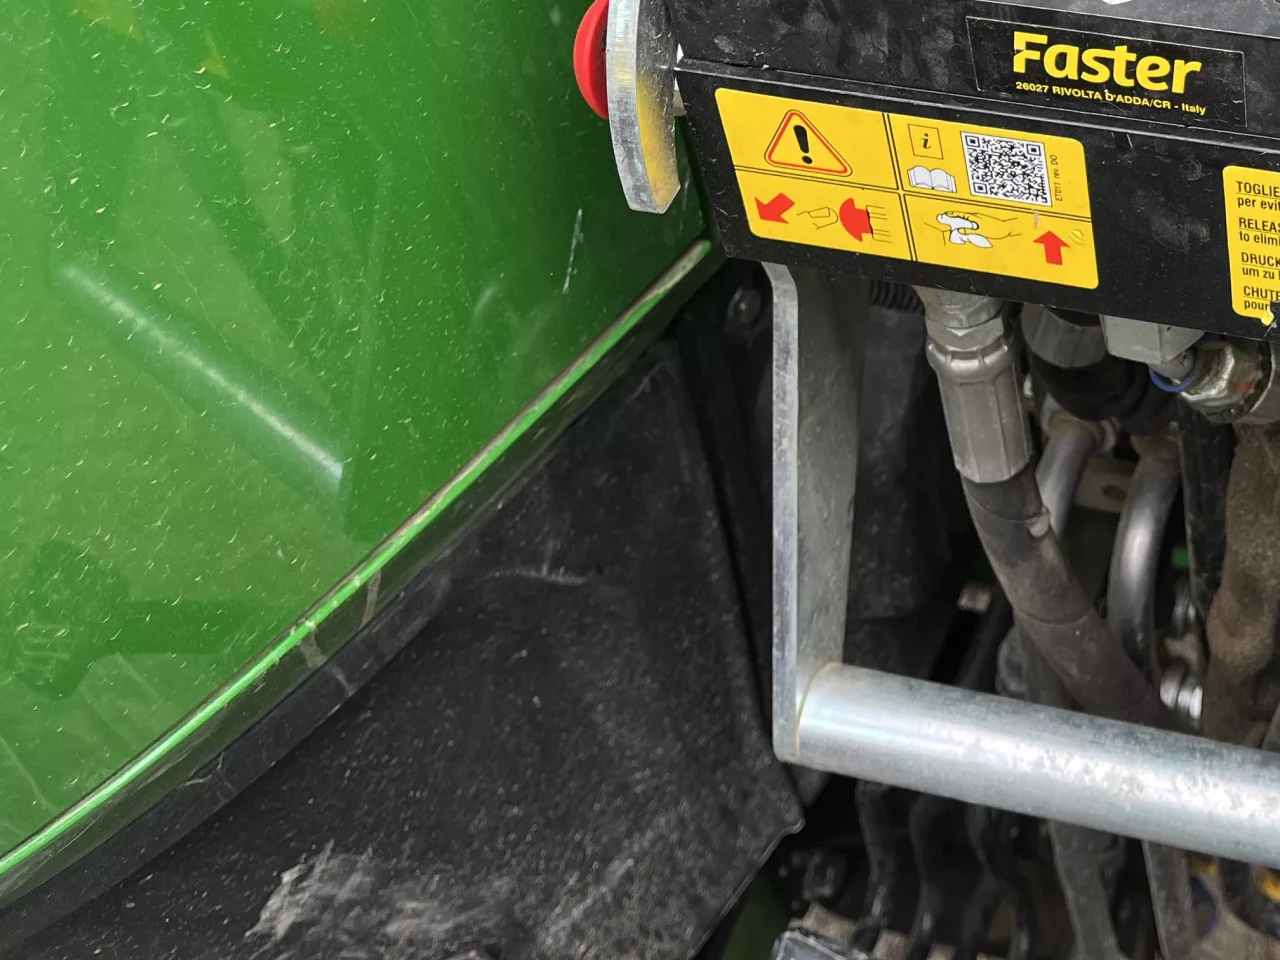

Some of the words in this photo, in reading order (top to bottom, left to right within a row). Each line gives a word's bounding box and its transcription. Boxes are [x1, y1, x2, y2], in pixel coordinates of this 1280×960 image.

[1013, 31, 1202, 95] Faster
[1015, 81, 1049, 94] 26027
[1052, 86, 1102, 101] RIVOLTA
[1181, 103, 1206, 116] Italy
[1237, 197, 1256, 208] per
[1239, 231, 1250, 241] to
[1242, 267, 1260, 277] um
[1262, 270, 1275, 280] zu
[1244, 299, 1270, 312] pour
